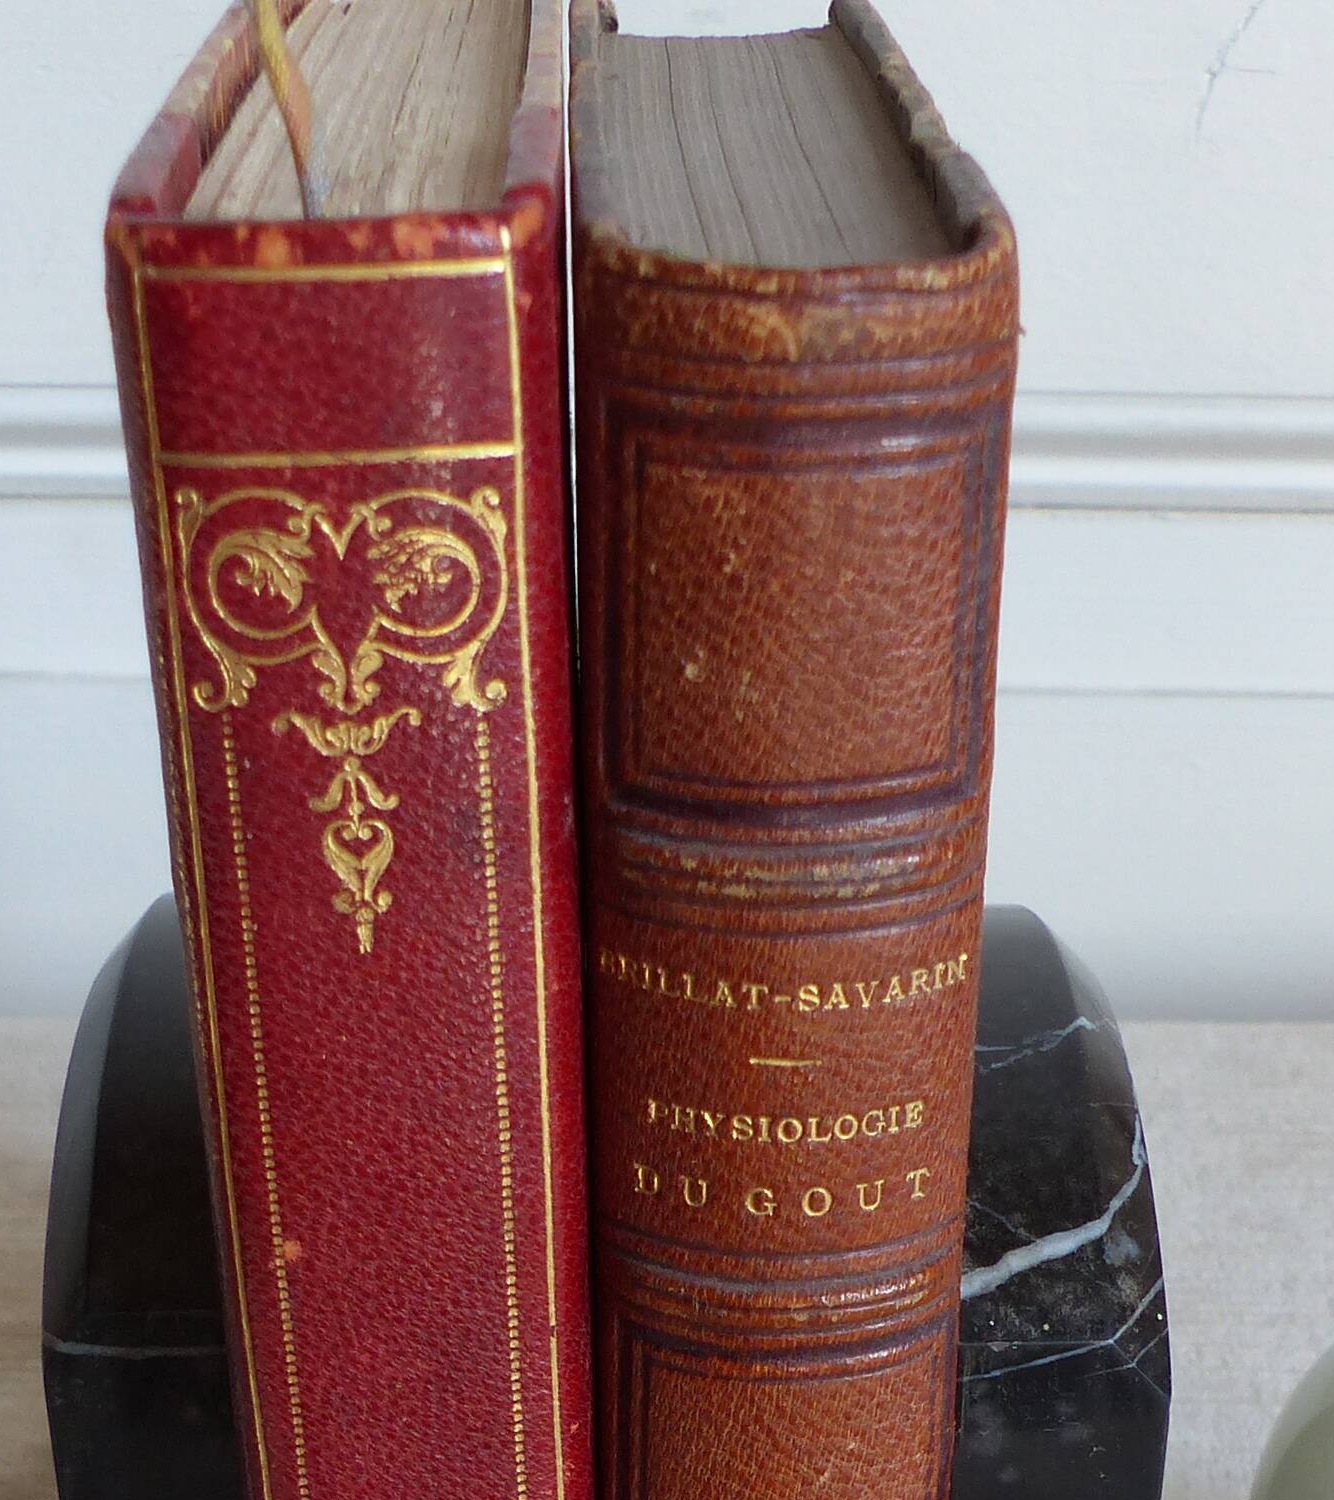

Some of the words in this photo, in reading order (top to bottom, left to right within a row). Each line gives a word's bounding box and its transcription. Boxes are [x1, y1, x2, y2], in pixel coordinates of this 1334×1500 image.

[598, 950, 969, 1012] BRILLAT-SAVARIN
[647, 1099, 926, 1143] PHYSIOLOGIE
[633, 1162, 709, 1208] DU
[744, 1167, 931, 1217] GOUT
